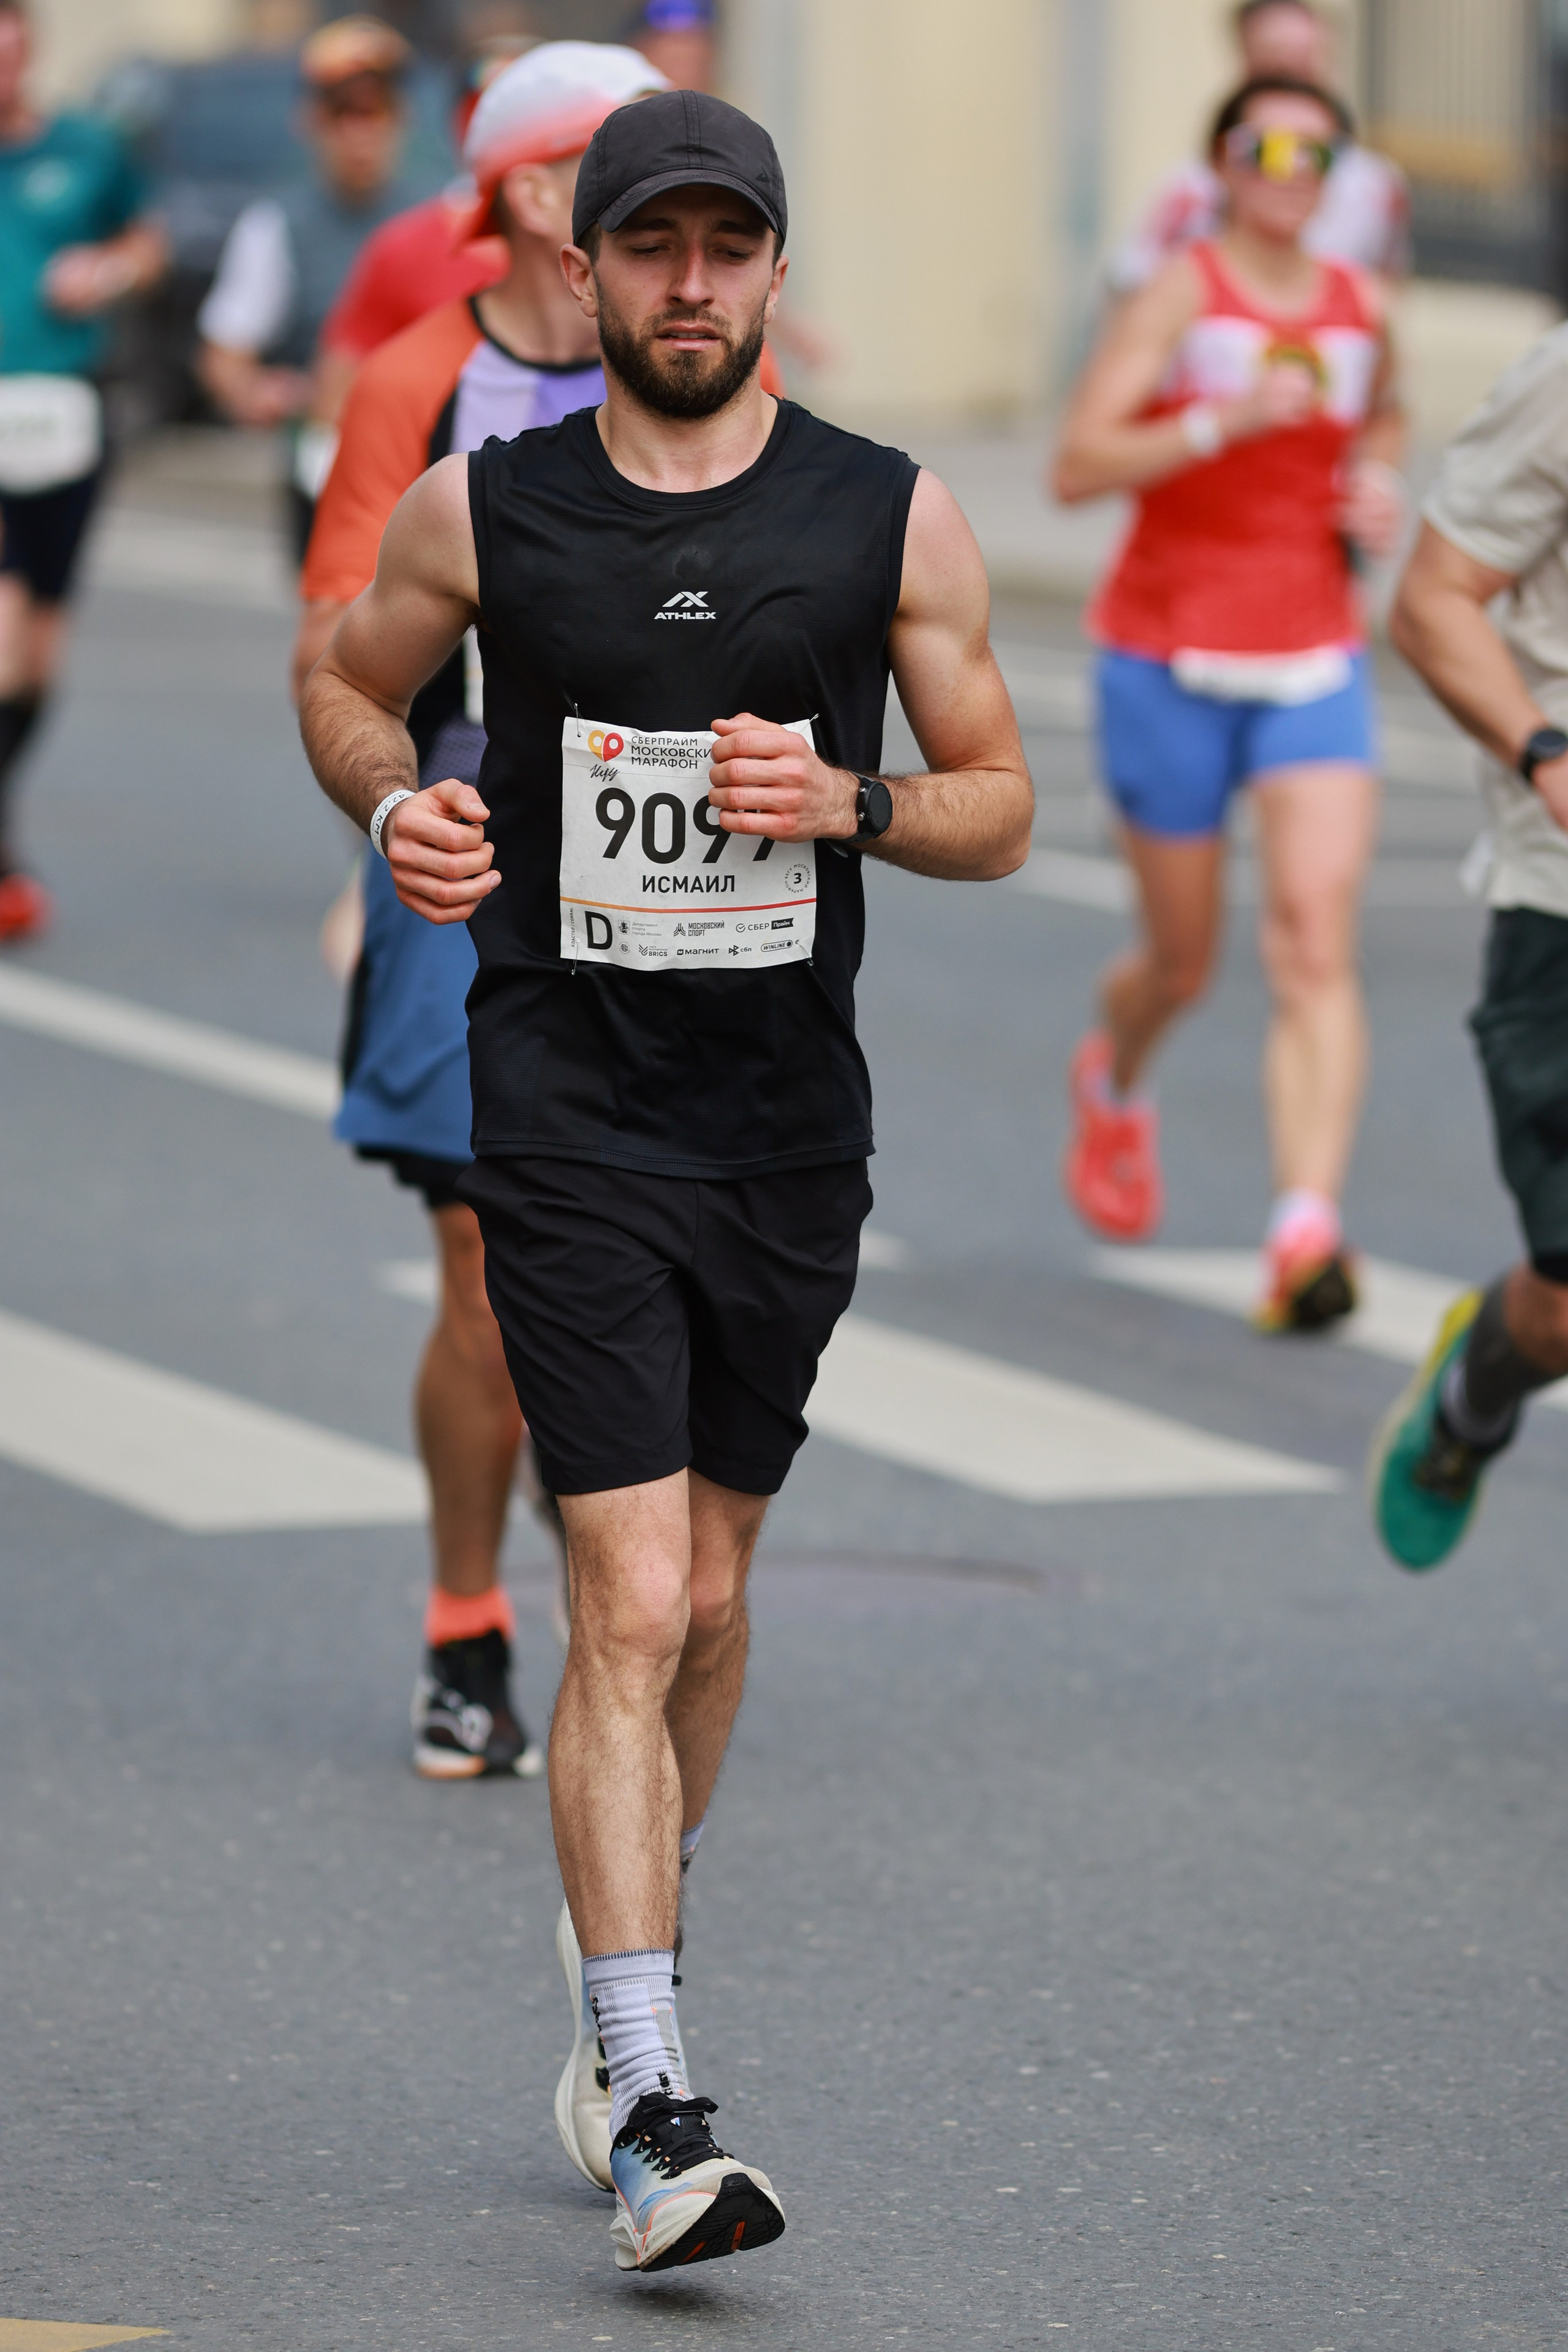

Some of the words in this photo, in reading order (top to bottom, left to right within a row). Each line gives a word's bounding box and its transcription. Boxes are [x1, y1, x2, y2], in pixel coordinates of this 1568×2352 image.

[631, 736, 698, 745] СБЕРПРАЙМ
[631, 745, 711, 758] МОСКОВСКИ
[631, 756, 698, 769] МАРАФОН
[643, 875, 735, 893] ИСМАИЛ
[794, 873, 802, 884] 3
[584, 911, 612, 950] D
[688, 920, 725, 929] МОСКОВСКИЙ
